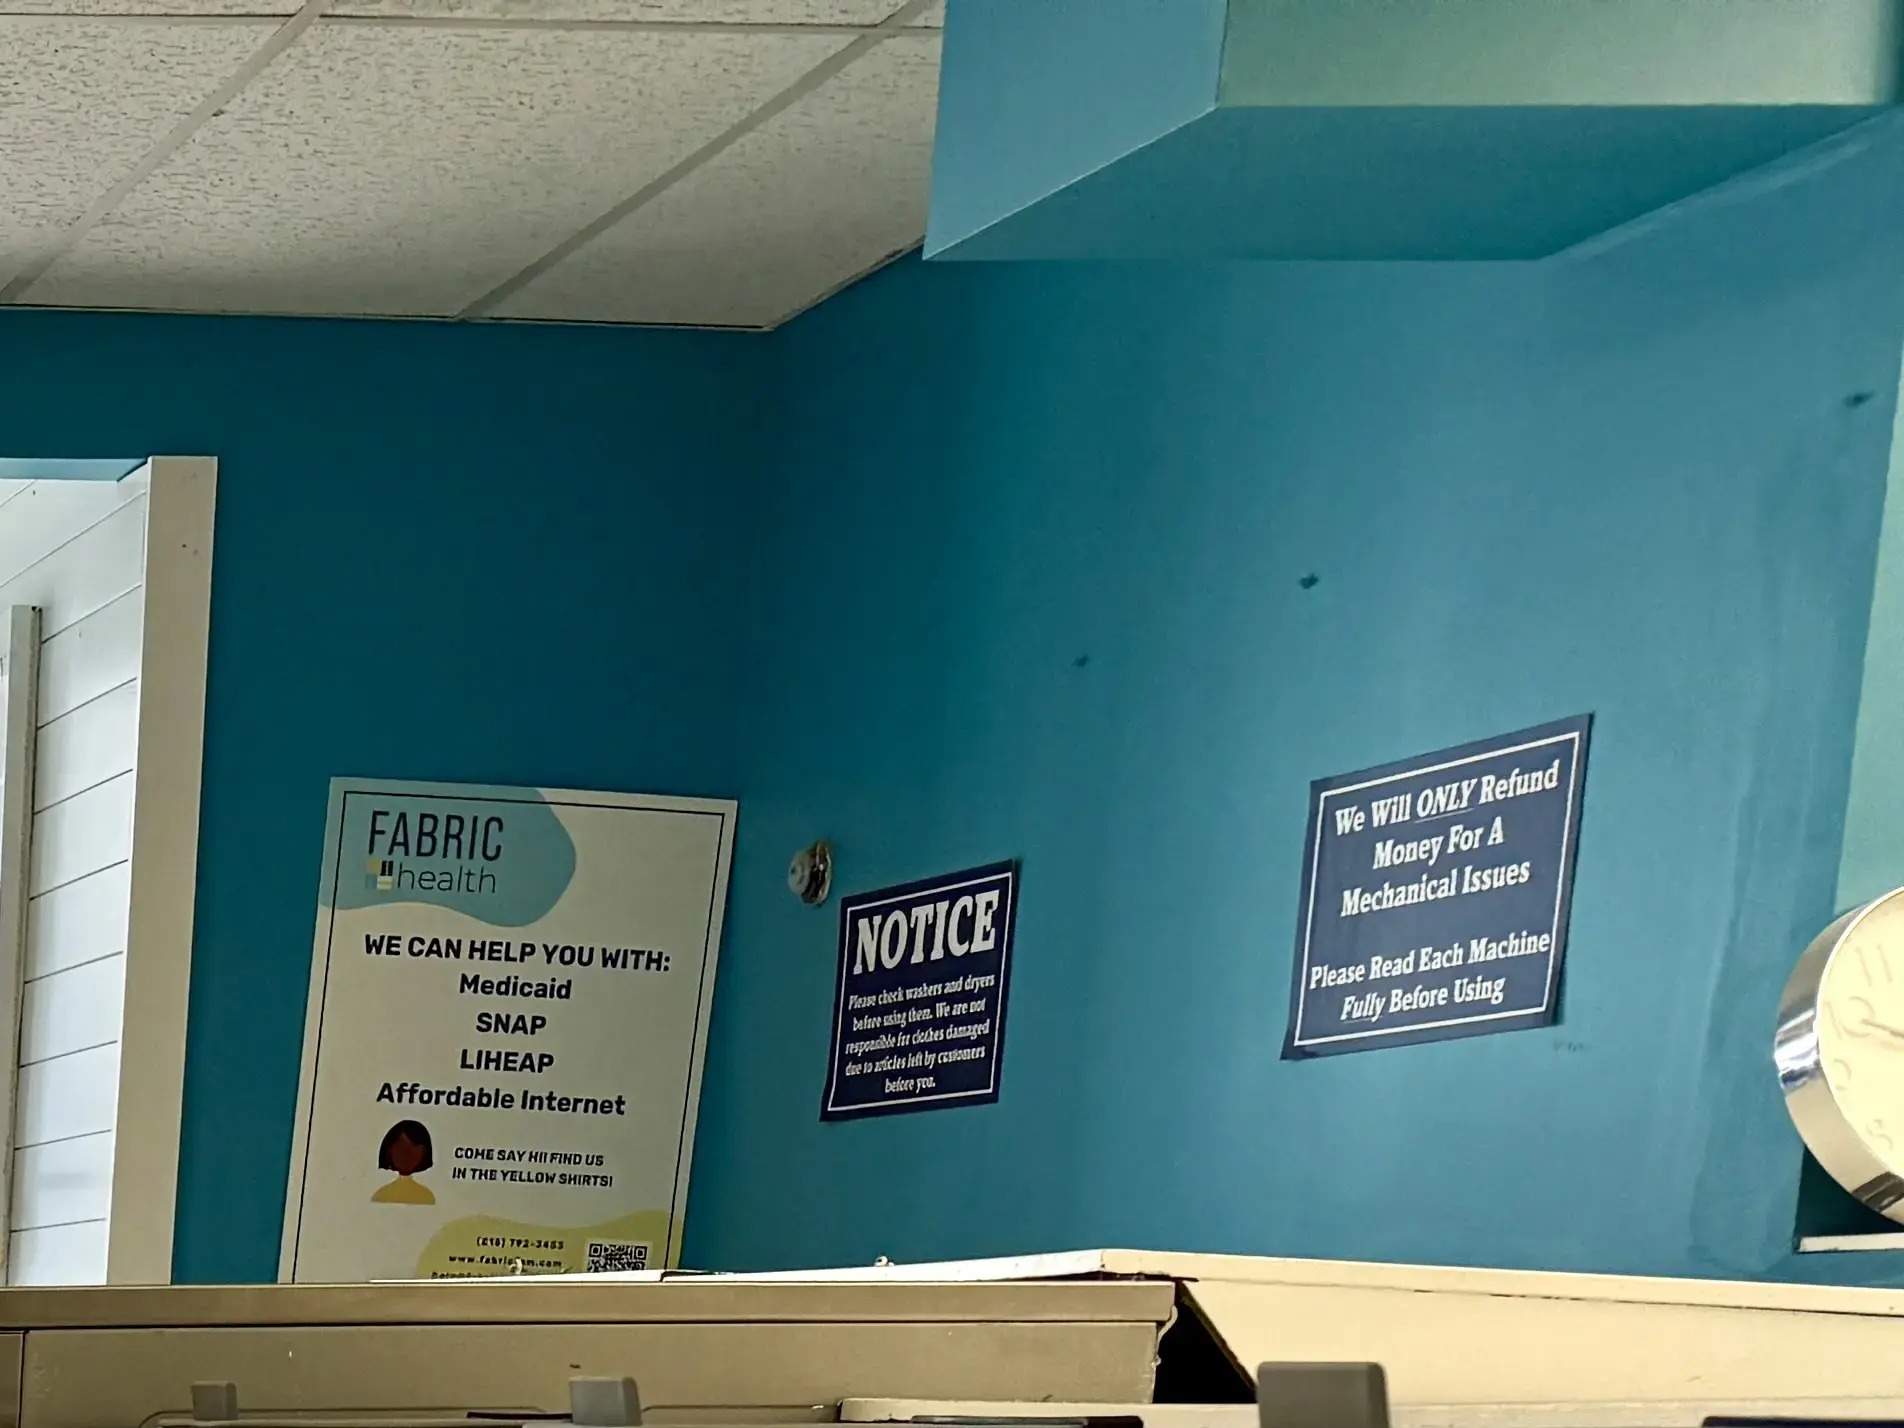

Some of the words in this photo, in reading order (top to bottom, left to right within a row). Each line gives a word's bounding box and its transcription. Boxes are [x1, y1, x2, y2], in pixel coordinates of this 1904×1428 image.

[1335, 805, 1365, 836] We
[1371, 793, 1411, 829] Will
[1416, 777, 1476, 819] ONLY
[1479, 759, 1560, 804] Refund
[367, 809, 504, 863] FABRIC
[1373, 835, 1443, 870] Money
[1447, 825, 1483, 854] For
[1488, 816, 1504, 845] A
[396, 864, 498, 894] health
[1340, 868, 1457, 918] Mechanical
[1463, 860, 1532, 894] Issues
[853, 889, 1000, 975] NOTICE
[365, 933, 401, 957] WE
[407, 935, 461, 960] CAN
[468, 939, 536, 964] HELP
[541, 944, 594, 967] YOU
[601, 948, 672, 973] WITH:
[1309, 963, 1366, 990] Please
[1369, 949, 1416, 981] Read
[1418, 942, 1464, 974] Each
[1467, 930, 1550, 964] Machine
[459, 973, 572, 1000] Medicaid
[848, 994, 876, 1010] Please
[878, 987, 904, 1005] check
[906, 982, 942, 1000] washers
[944, 976, 963, 994] and
[965, 974, 995, 994] dryers
[1340, 994, 1384, 1023] Fully
[1389, 986, 1448, 1015] Before
[1454, 976, 1505, 1005] Using
[475, 1012, 547, 1036] SNAP
[853, 1015, 882, 1031] before
[884, 1012, 907, 1028] using
[908, 1007, 933, 1023] them.
[936, 1002, 948, 1018] We
[951, 1003, 967, 1015] are
[970, 998, 986, 1012] not
[845, 1034, 895, 1056] responsible
[897, 1032, 910, 1047] for
[912, 1028, 944, 1044] clothes
[946, 1018, 990, 1042] damaged
[460, 1049, 555, 1074] LIHEAP
[845, 1061, 861, 1076] due
[863, 1062, 873, 1074] to
[874, 1055, 906, 1072] articles
[907, 1051, 922, 1068] left
[924, 1051, 936, 1069] by
[938, 1046, 986, 1064] customers
[376, 1082, 515, 1109] Affordable
[521, 1089, 626, 1117] Internet
[885, 1077, 914, 1093] before
[916, 1076, 936, 1094] you.
[454, 1147, 495, 1161] COME
[497, 1149, 526, 1162] SAY
[550, 1152, 582, 1166] FIND
[585, 1154, 604, 1167] US
[452, 1167, 466, 1179] IN
[470, 1168, 497, 1180] THE
[500, 1170, 556, 1183] YELLOW
[558, 1173, 613, 1187] SHIRTS!
